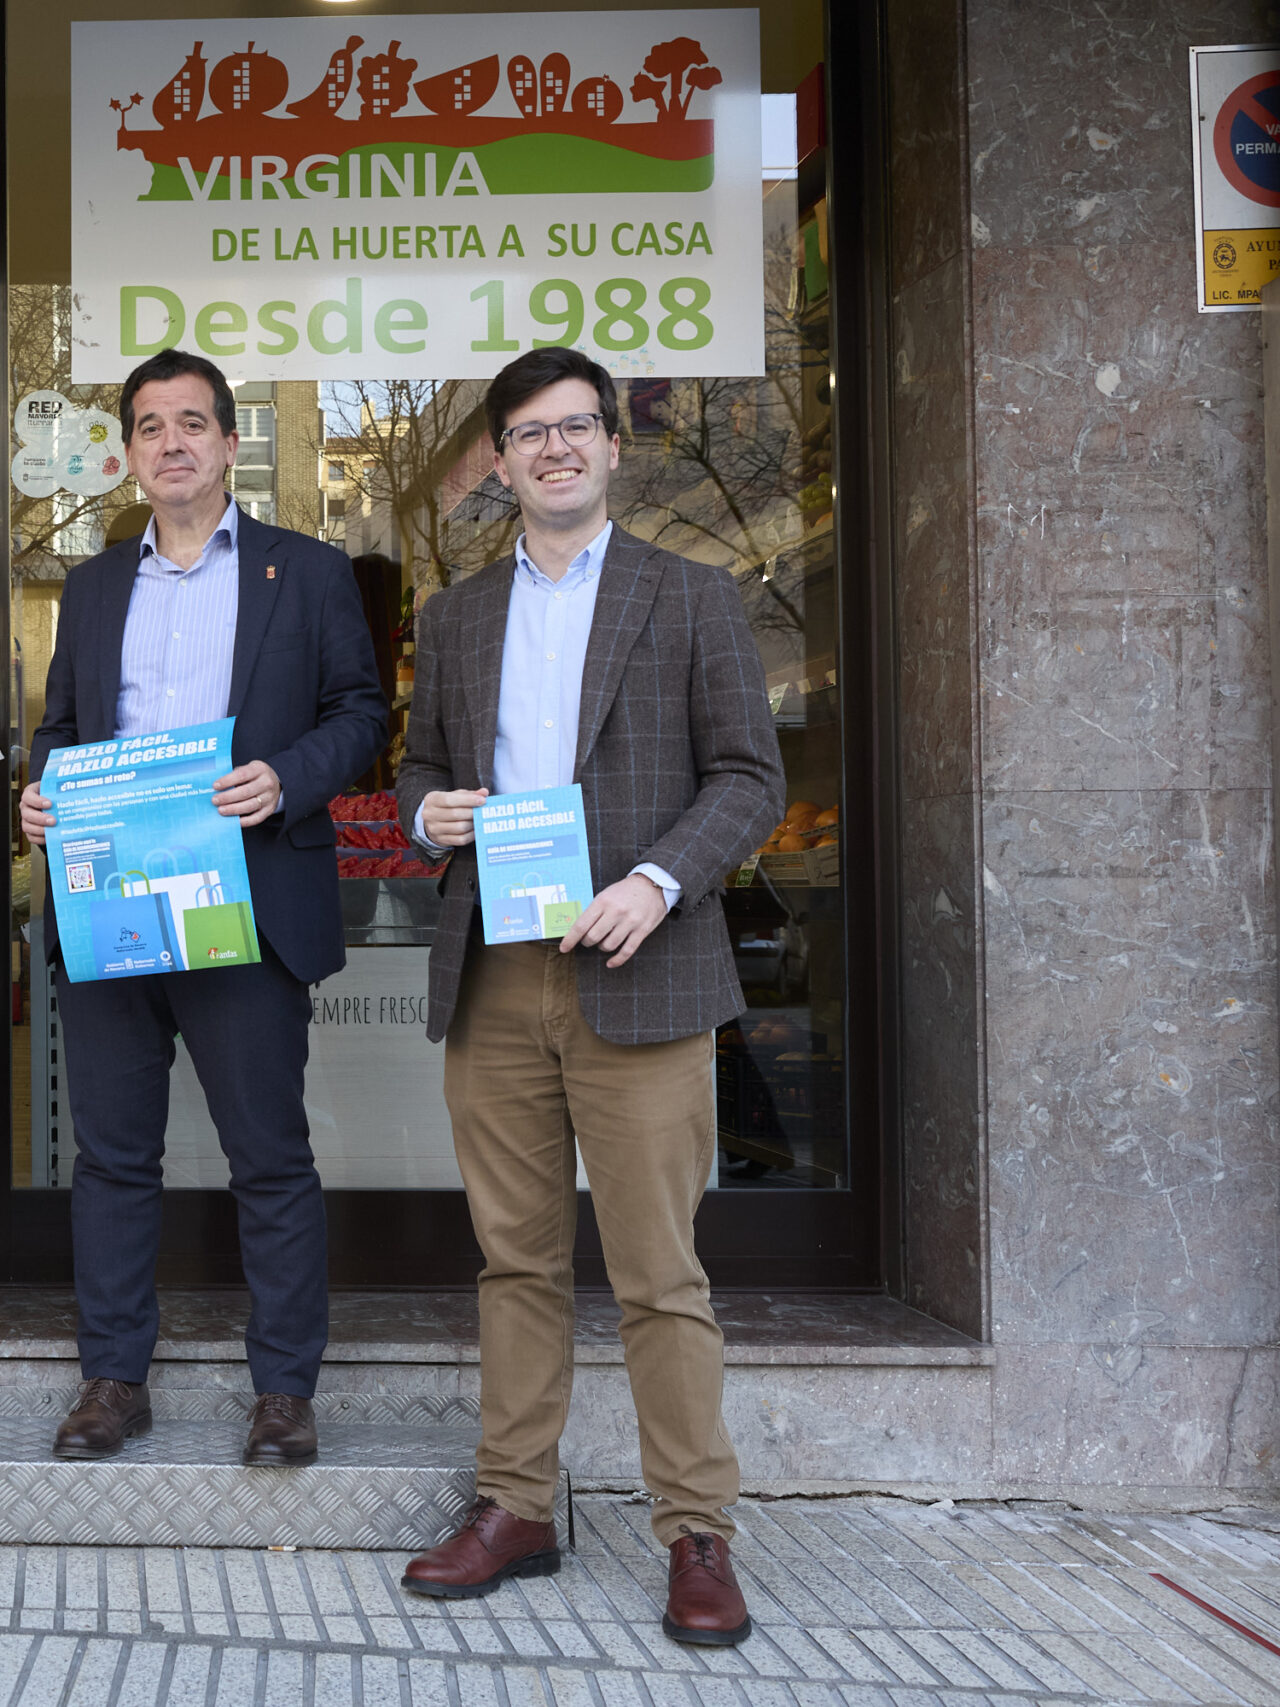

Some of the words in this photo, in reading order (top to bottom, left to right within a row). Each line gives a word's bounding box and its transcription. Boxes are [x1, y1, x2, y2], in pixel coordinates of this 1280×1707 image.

[1235, 143, 1280, 154] PERM
[177, 151, 491, 200] VIRGINIA
[212, 228, 260, 261] DE
[274, 227, 320, 260] LA
[333, 225, 486, 259] HUERTA
[497, 224, 525, 257] A
[547, 223, 597, 257] SU
[611, 222, 713, 256] CASA
[1246, 240, 1280, 252] AYU
[1212, 290, 1232, 300] LIC.
[120, 277, 429, 356] Desde
[470, 277, 714, 352] 1988
[28, 401, 63, 413] RED
[57, 756, 114, 777] HAZLO
[116, 737, 218, 766] ACCESIBLE
[62, 743, 118, 762] HAZLO
[121, 733, 175, 751] FÁCIL,
[482, 803, 514, 819] HAZLO
[483, 819, 516, 834] HAZLO
[518, 810, 576, 829] ACCESIBLE
